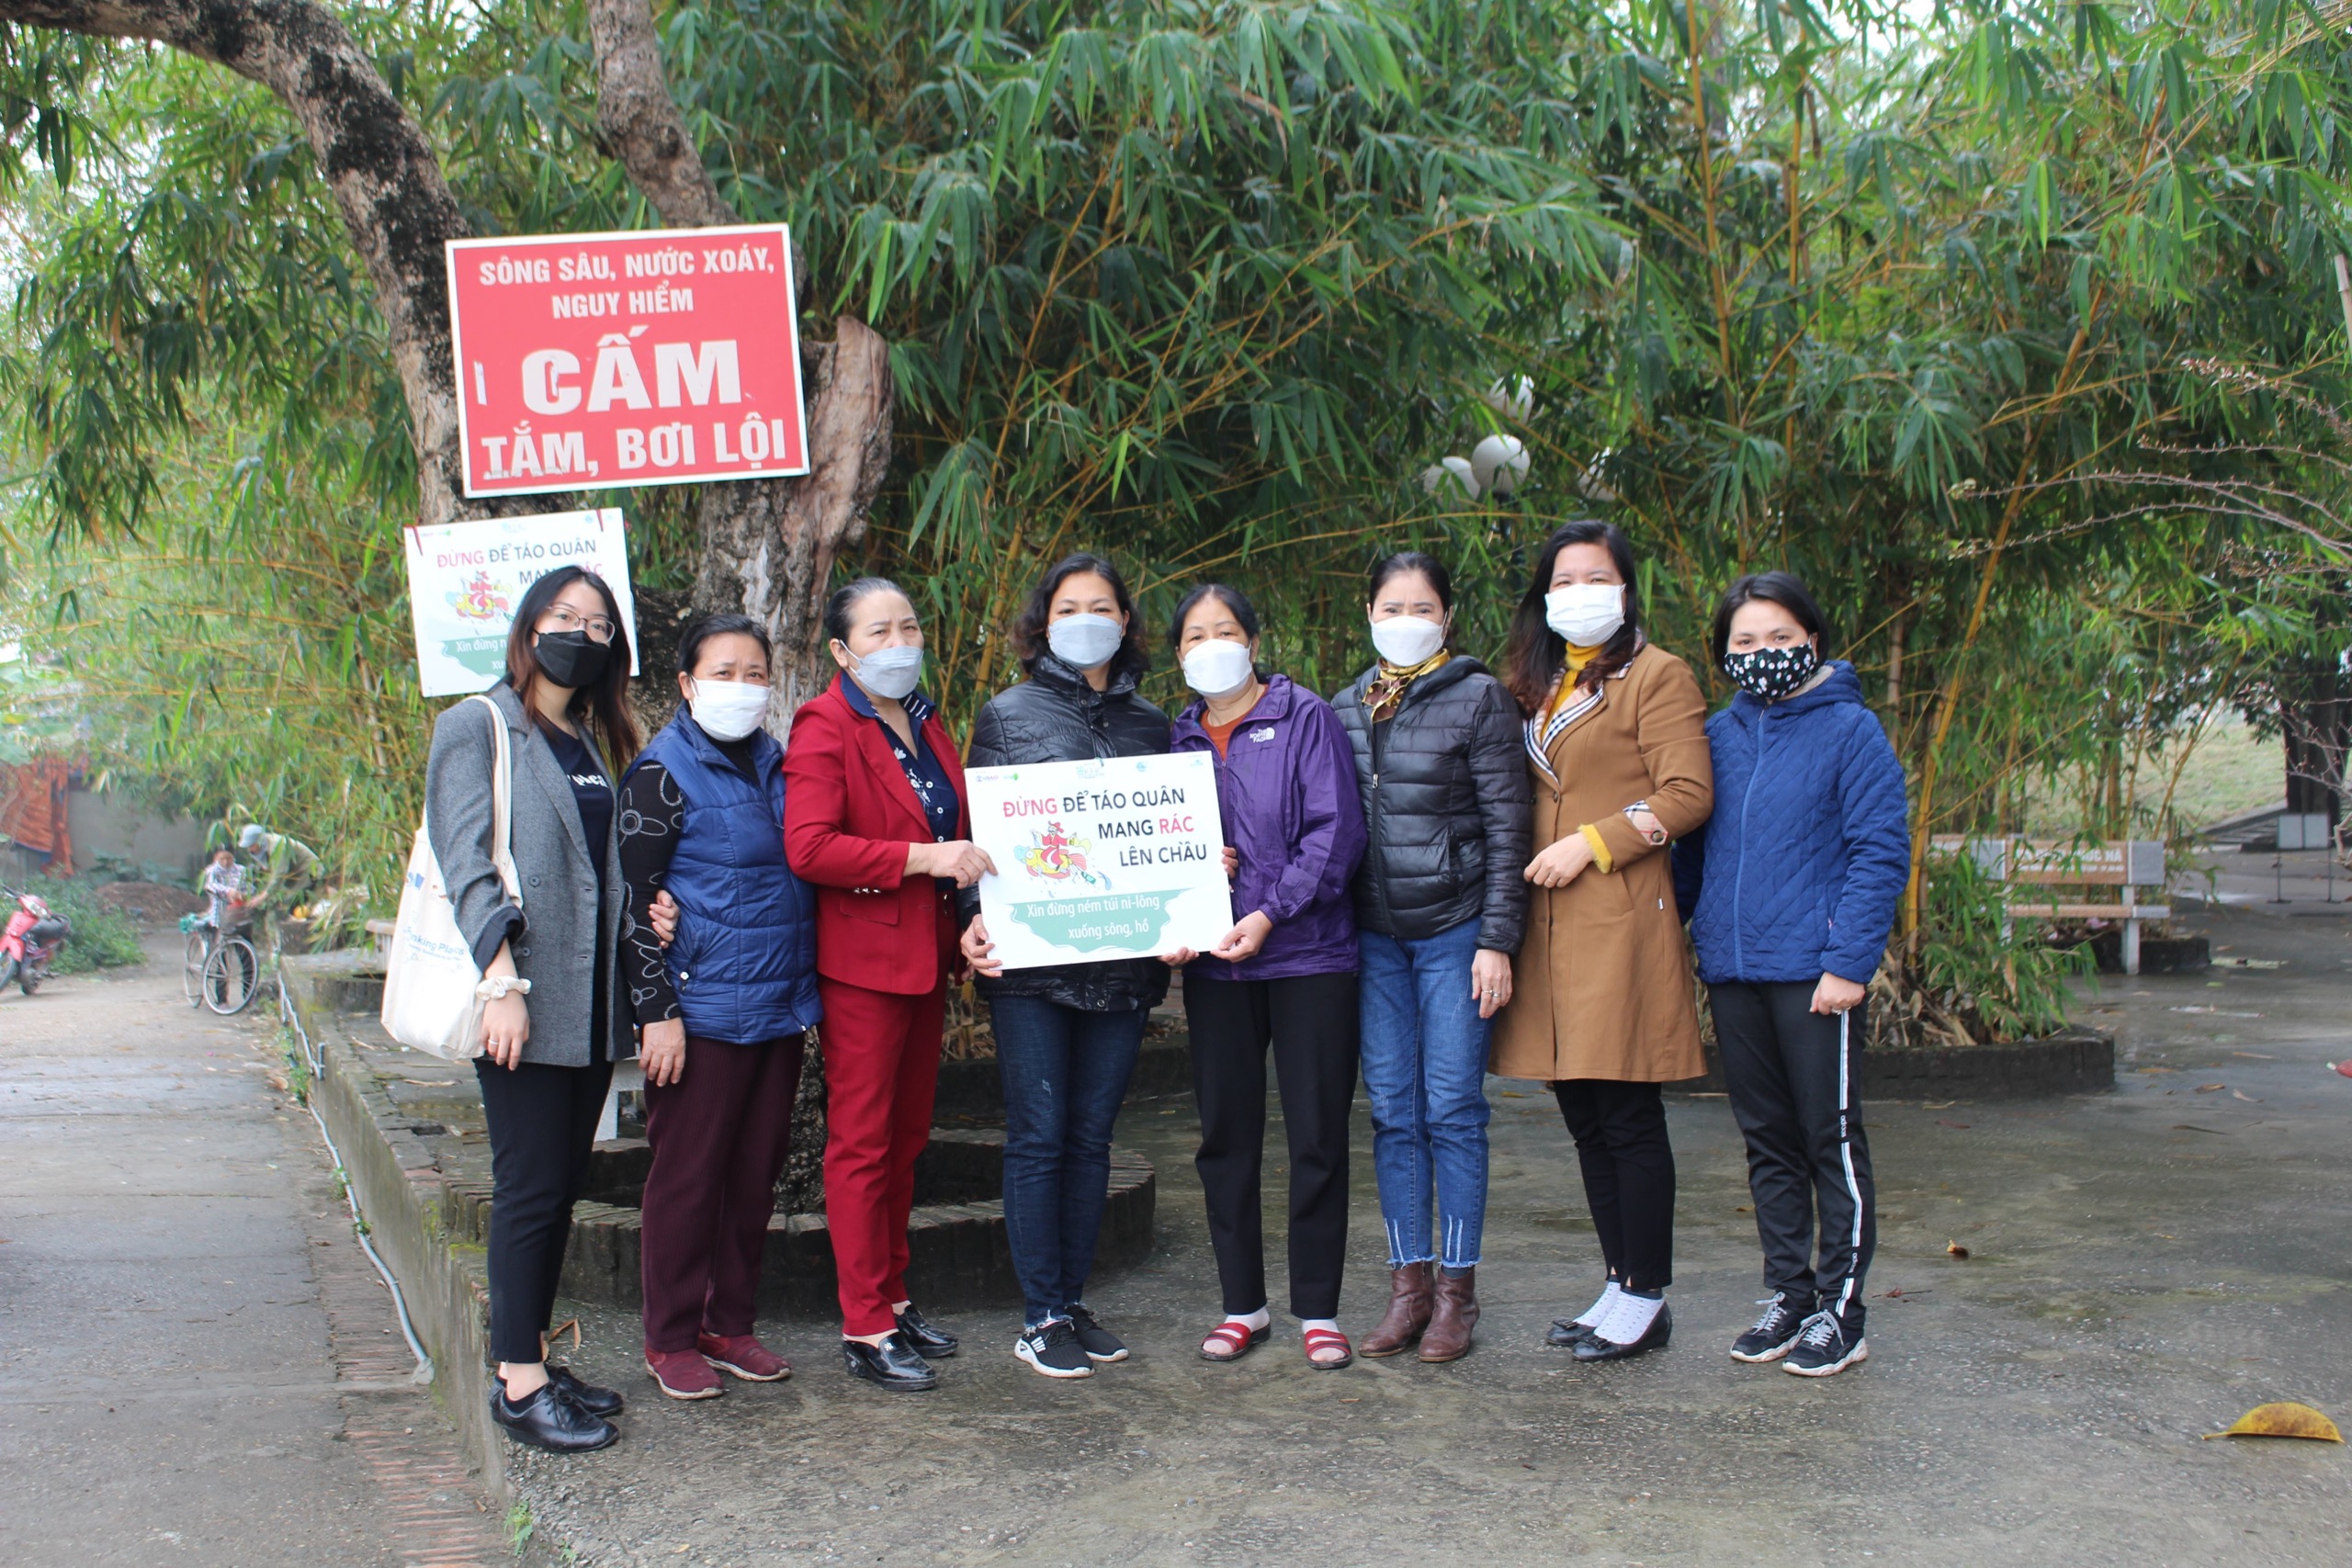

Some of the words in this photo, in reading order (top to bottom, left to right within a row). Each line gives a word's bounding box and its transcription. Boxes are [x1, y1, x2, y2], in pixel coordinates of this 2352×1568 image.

[480, 255, 550, 286] SÔNG
[558, 252, 616, 282] SÂU,
[625, 245, 695, 277] NƯỚC
[703, 243, 775, 274] XOÁY,
[552, 292, 619, 319] NGUY
[628, 280, 694, 315] HIỂM
[521, 324, 741, 415] CẤM
[481, 420, 599, 478] TẮM,
[616, 421, 695, 470] BƠI
[713, 411, 786, 470] LỘI
[436, 548, 484, 568] ĐỪNG
[514, 542, 545, 559] TÁO
[549, 537, 596, 557] QUÂN
[519, 568, 559, 585] MA
[456, 639, 472, 652] Xin
[1003, 795, 1057, 818] ĐỪNG
[1063, 790, 1090, 813] ĐỂ
[1091, 790, 1126, 810] TÁO
[1132, 785, 1185, 807] QUÂN
[1098, 819, 1154, 840] MANG
[1159, 813, 1194, 835] RÁC
[1119, 846, 1153, 867] LÊN
[1158, 840, 1207, 863] CHẦU
[1027, 904, 1045, 918] Xin
[1047, 902, 1075, 918] đừng
[1078, 900, 1102, 913] ném
[1103, 897, 1119, 911] túi
[1121, 895, 1159, 910] ni-lông
[1068, 923, 1102, 940] xuống
[1104, 921, 1133, 937] sông,
